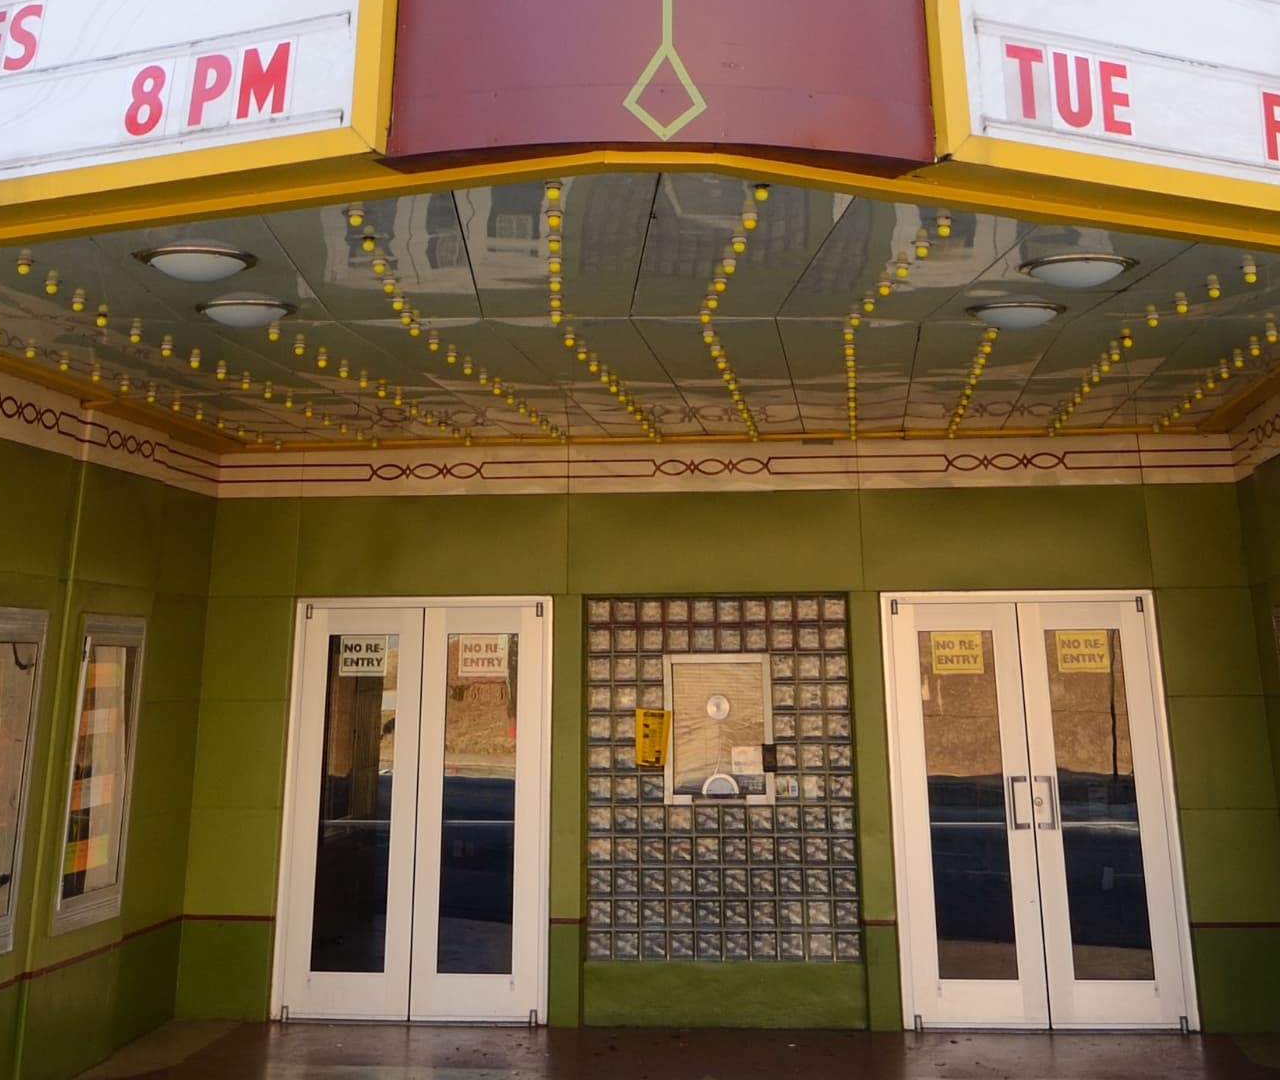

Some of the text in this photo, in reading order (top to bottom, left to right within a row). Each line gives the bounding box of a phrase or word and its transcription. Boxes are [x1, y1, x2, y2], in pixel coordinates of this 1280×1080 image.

[1006, 44, 1131, 135] TUE
[344, 643, 384, 653] NO RE-
[463, 643, 481, 653] NO
[936, 640, 979, 650] NO RE-
[1062, 639, 1105, 649] NO RE-
[343, 657, 383, 667] ENTRY
[463, 657, 503, 667] ENTRY
[938, 654, 978, 664] ENTRY
[1063, 653, 1105, 663] ENTRY
